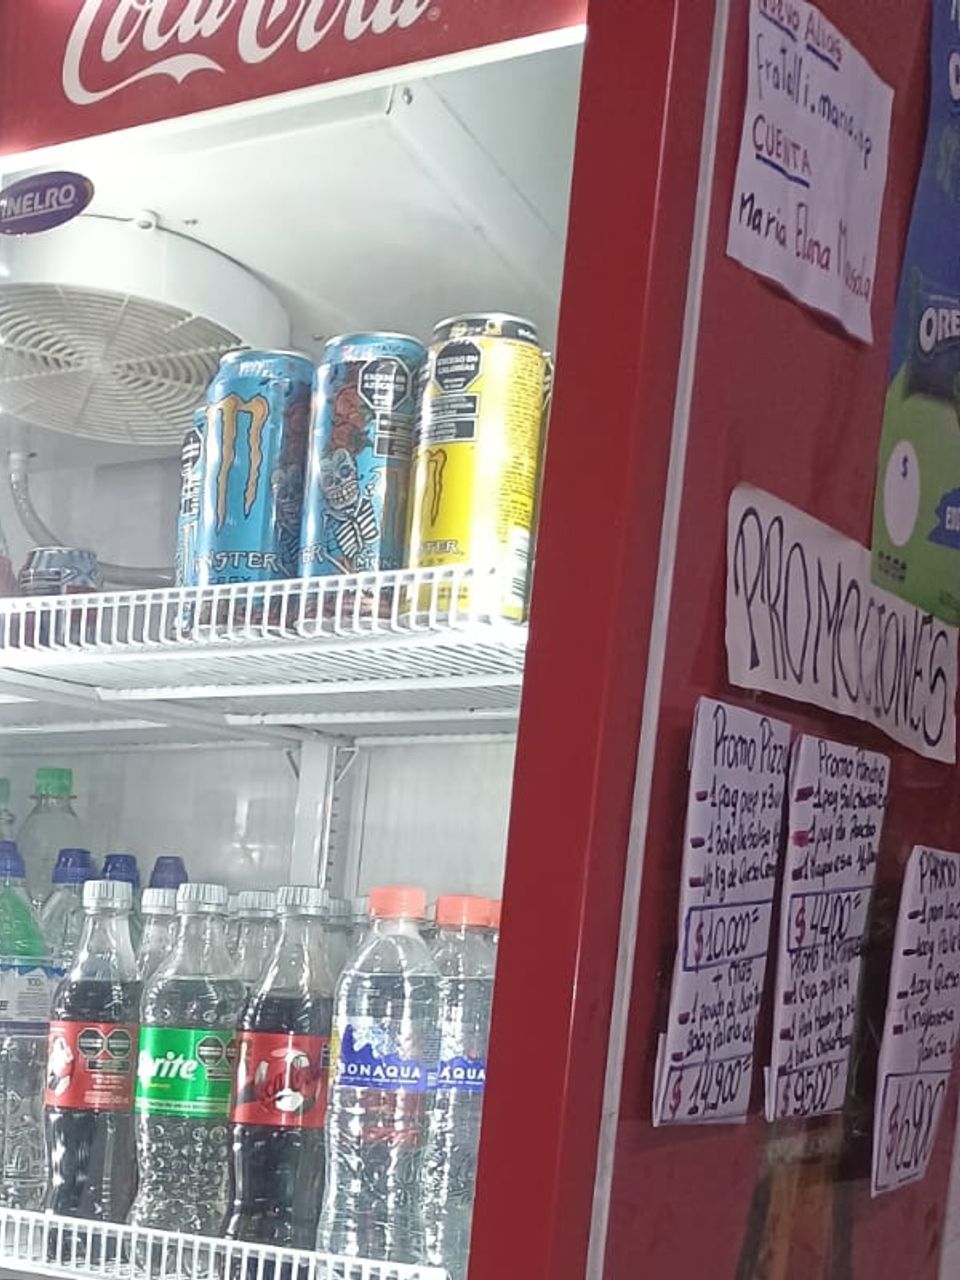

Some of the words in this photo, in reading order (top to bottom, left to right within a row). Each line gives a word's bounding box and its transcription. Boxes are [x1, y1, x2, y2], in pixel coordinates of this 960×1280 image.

[752, 114, 812, 177] CUENTA
[713, 704, 756, 771] Promo
[141, 1051, 198, 1081] rite
